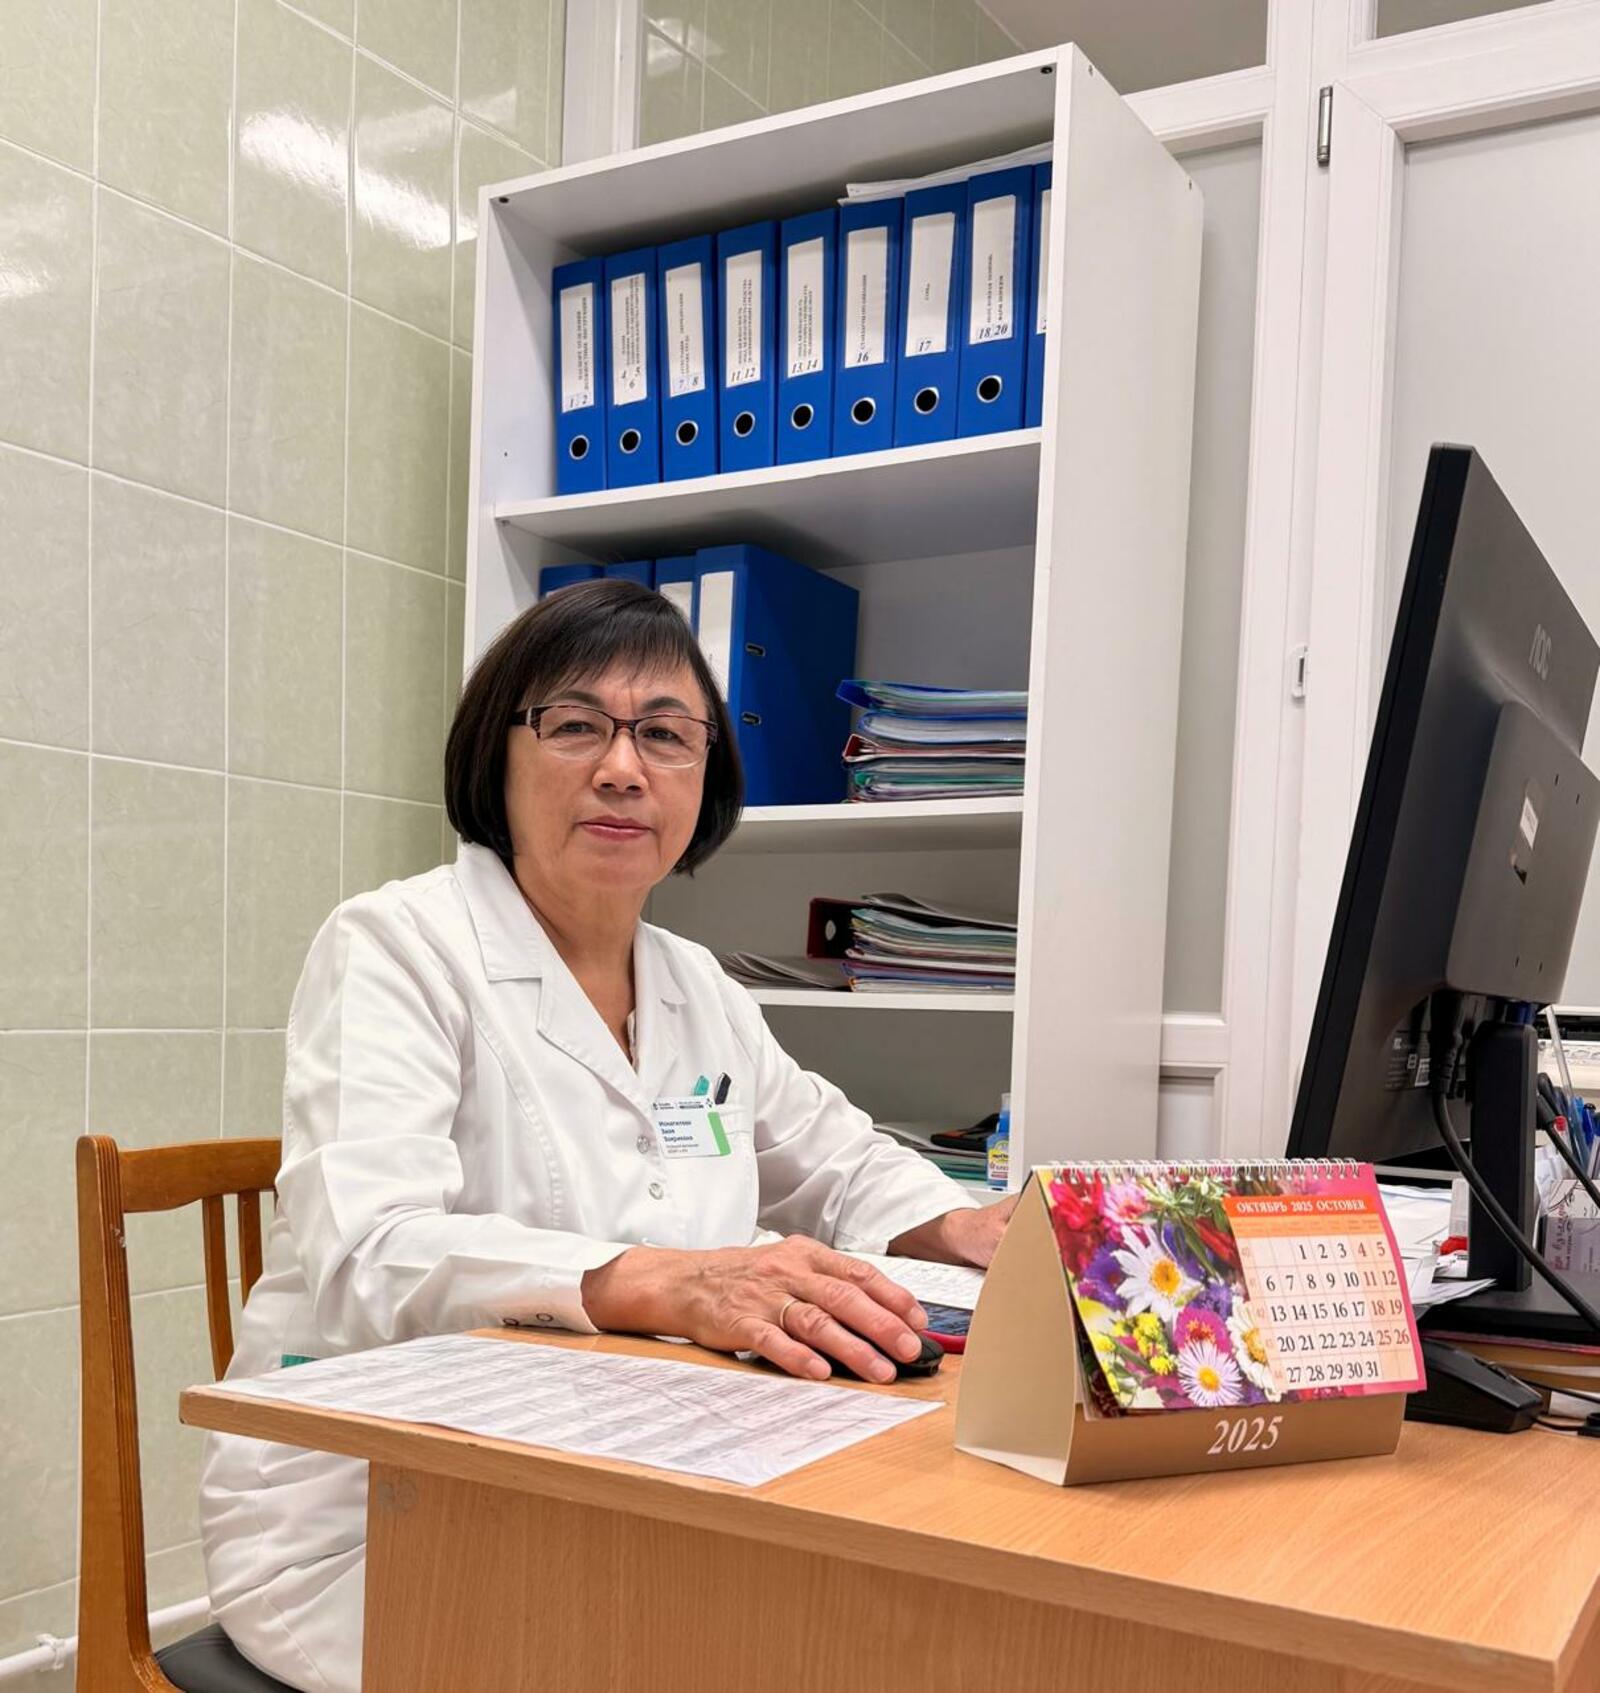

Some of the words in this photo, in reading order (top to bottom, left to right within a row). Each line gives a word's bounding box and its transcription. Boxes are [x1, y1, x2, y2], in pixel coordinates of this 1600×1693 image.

[978, 328, 990, 340] 18
[994, 324, 1008, 336] 20
[919, 340, 932, 352] 17
[807, 359, 818, 370] 14
[857, 351, 869, 363] 16
[745, 367, 755, 379] 12
[1236, 1200, 1288, 1213] ОКТЯБРЬ
[1291, 1200, 1313, 1212] 2025
[1316, 1199, 1367, 1212] OCTOBER
[1299, 1244, 1307, 1260] 1
[1317, 1243, 1328, 1259] 2
[1337, 1242, 1347, 1258] 3
[1357, 1242, 1367, 1257] 4
[1376, 1240, 1386, 1256] 5
[1266, 1275, 1276, 1291] 6
[1285, 1275, 1295, 1291] 7
[1306, 1274, 1317, 1289] 8
[1326, 1273, 1336, 1288] 9
[1344, 1271, 1359, 1287] 10
[1364, 1270, 1378, 1286] 11
[1382, 1269, 1397, 1285] 12
[1270, 1306, 1287, 1322] 13
[1291, 1305, 1308, 1320] 14
[1312, 1303, 1328, 1319] 15
[1332, 1302, 1348, 1318] 16
[1352, 1301, 1366, 1316] 17
[1371, 1300, 1385, 1315] 18
[1389, 1299, 1403, 1314] 19
[1277, 1336, 1295, 1352] 20
[1298, 1335, 1315, 1351] 21
[1319, 1333, 1337, 1349] 22
[1339, 1332, 1356, 1348] 23
[1359, 1330, 1375, 1347] 24
[1377, 1329, 1392, 1345] 25
[1394, 1328, 1410, 1345] 26
[1286, 1367, 1301, 1383] 27
[1306, 1365, 1325, 1381] 28
[1327, 1364, 1343, 1380] 29
[1348, 1362, 1363, 1378] 30
[1365, 1361, 1379, 1377] 31
[1207, 1415, 1284, 1455] 2025
